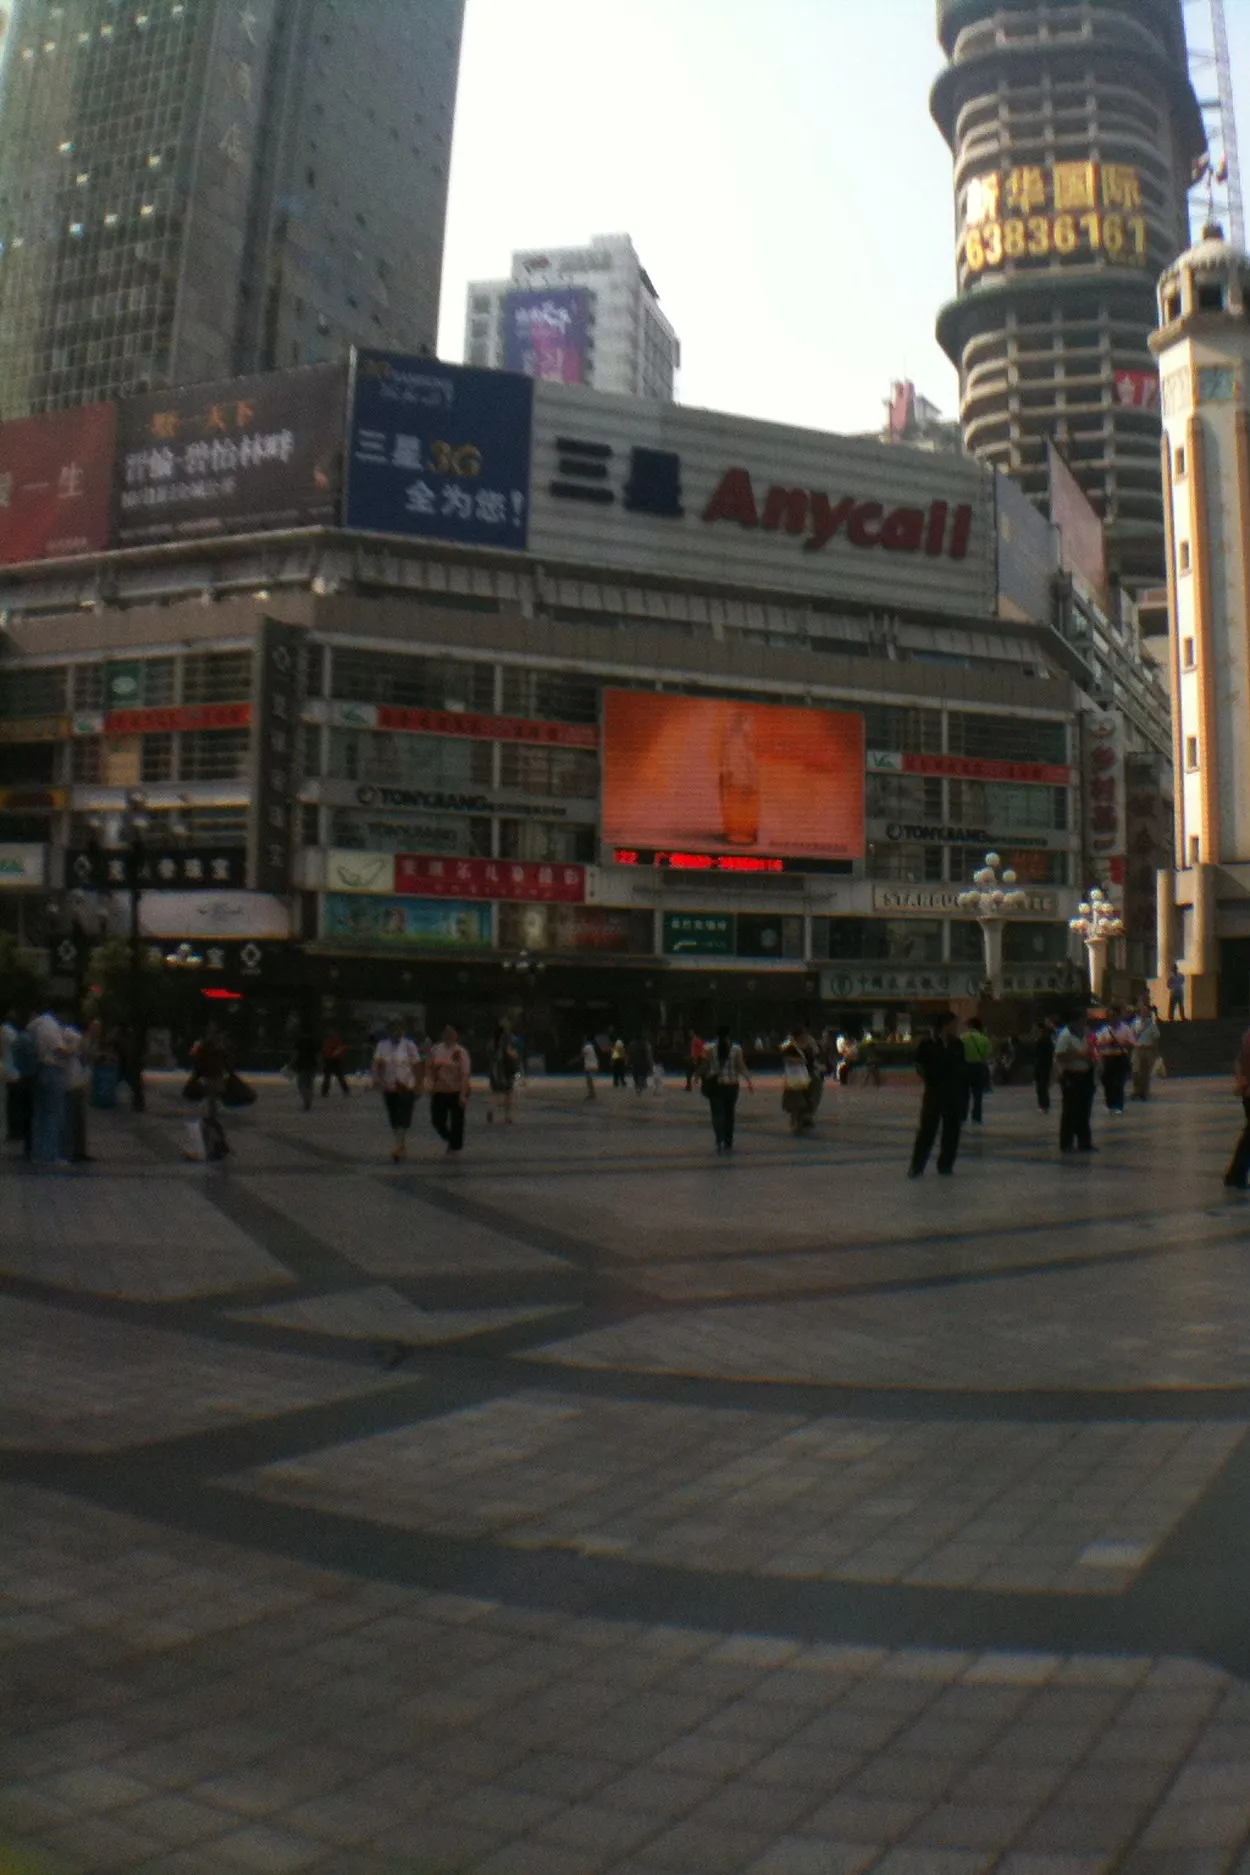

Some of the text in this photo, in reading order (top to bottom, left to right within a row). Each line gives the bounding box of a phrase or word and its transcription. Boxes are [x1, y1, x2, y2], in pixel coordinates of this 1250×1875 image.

[966, 161, 1142, 224] 新华国际
[966, 212, 1147, 271] 63836161
[550, 436, 973, 560] 三星 Anycall
